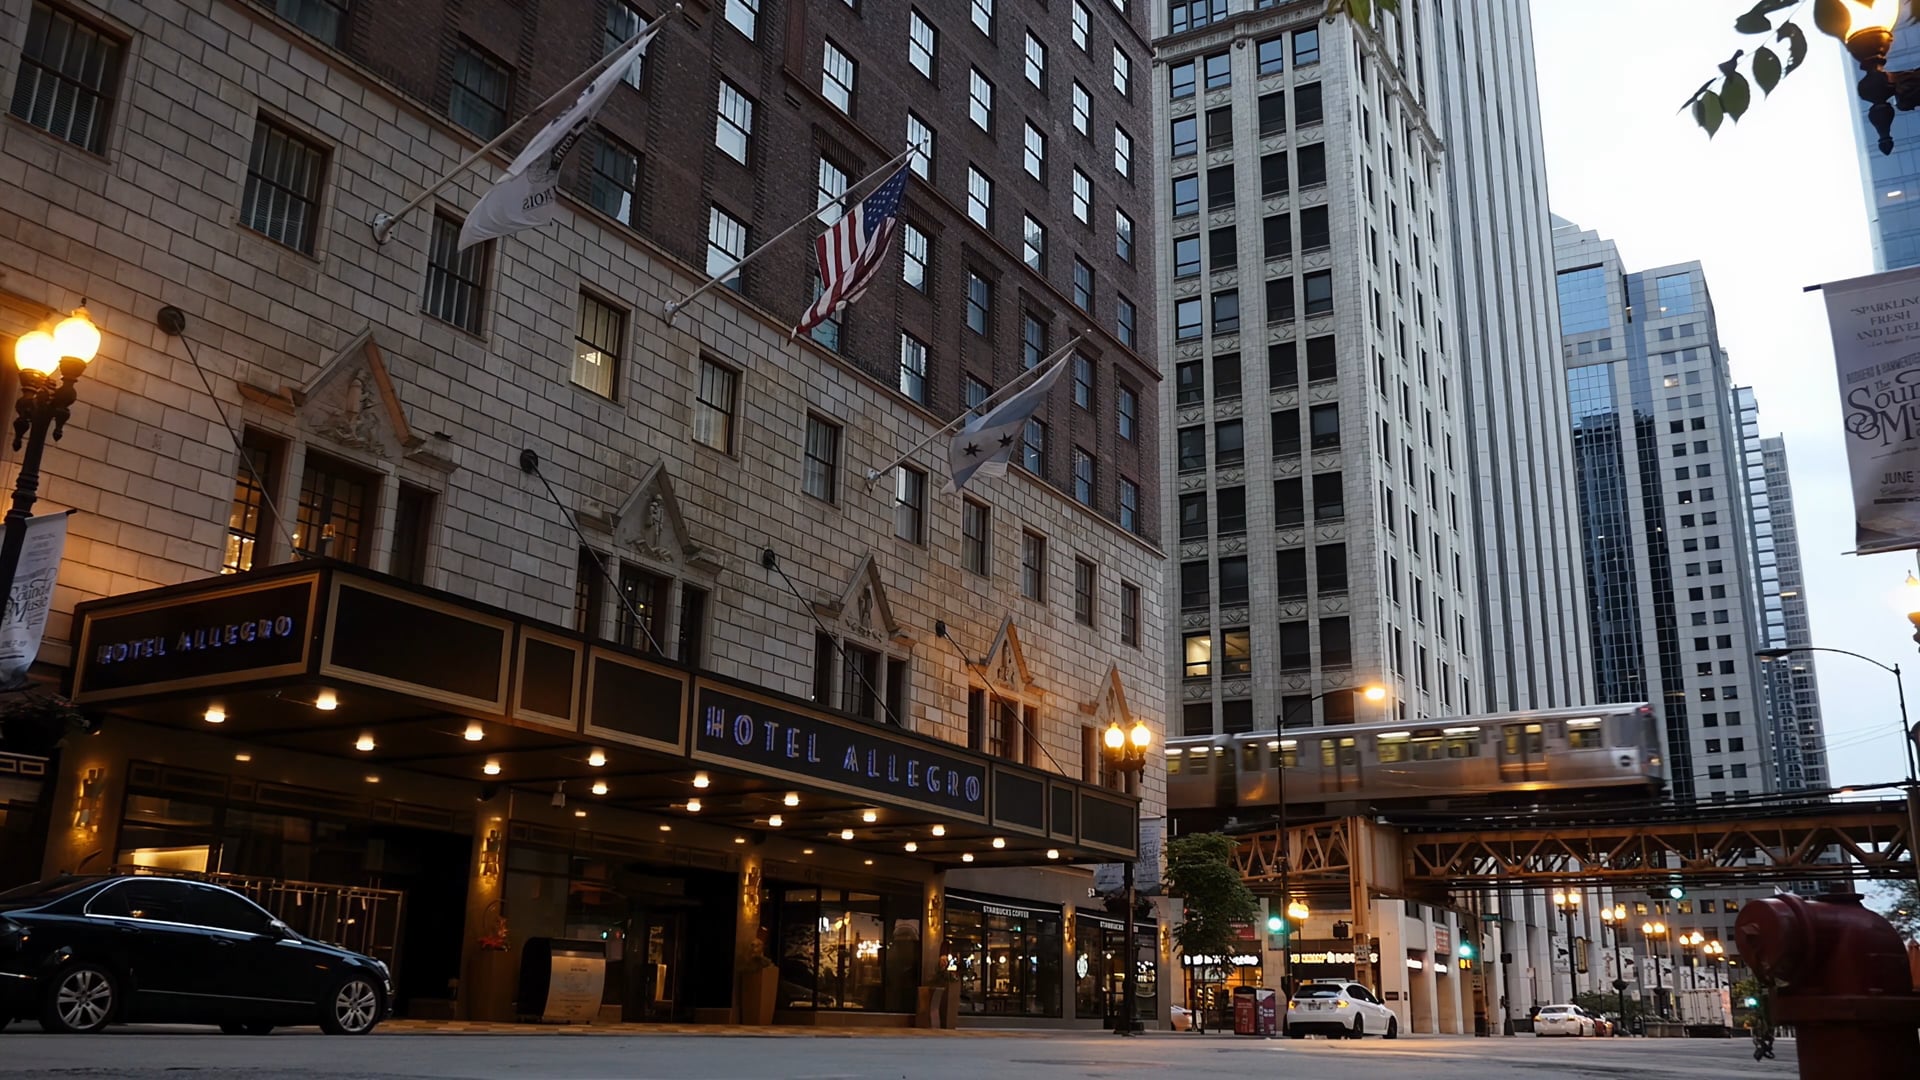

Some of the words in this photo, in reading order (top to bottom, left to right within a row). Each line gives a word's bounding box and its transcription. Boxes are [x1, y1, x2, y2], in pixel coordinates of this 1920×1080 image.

[1870, 310, 1911, 326] FRESH
[1881, 470, 1915, 485] JUNE
[96, 636, 166, 664] HOTEL
[176, 615, 292, 651] ALLEGRO
[706, 706, 821, 763] HOTEL
[843, 744, 980, 801] ALLEGRO
